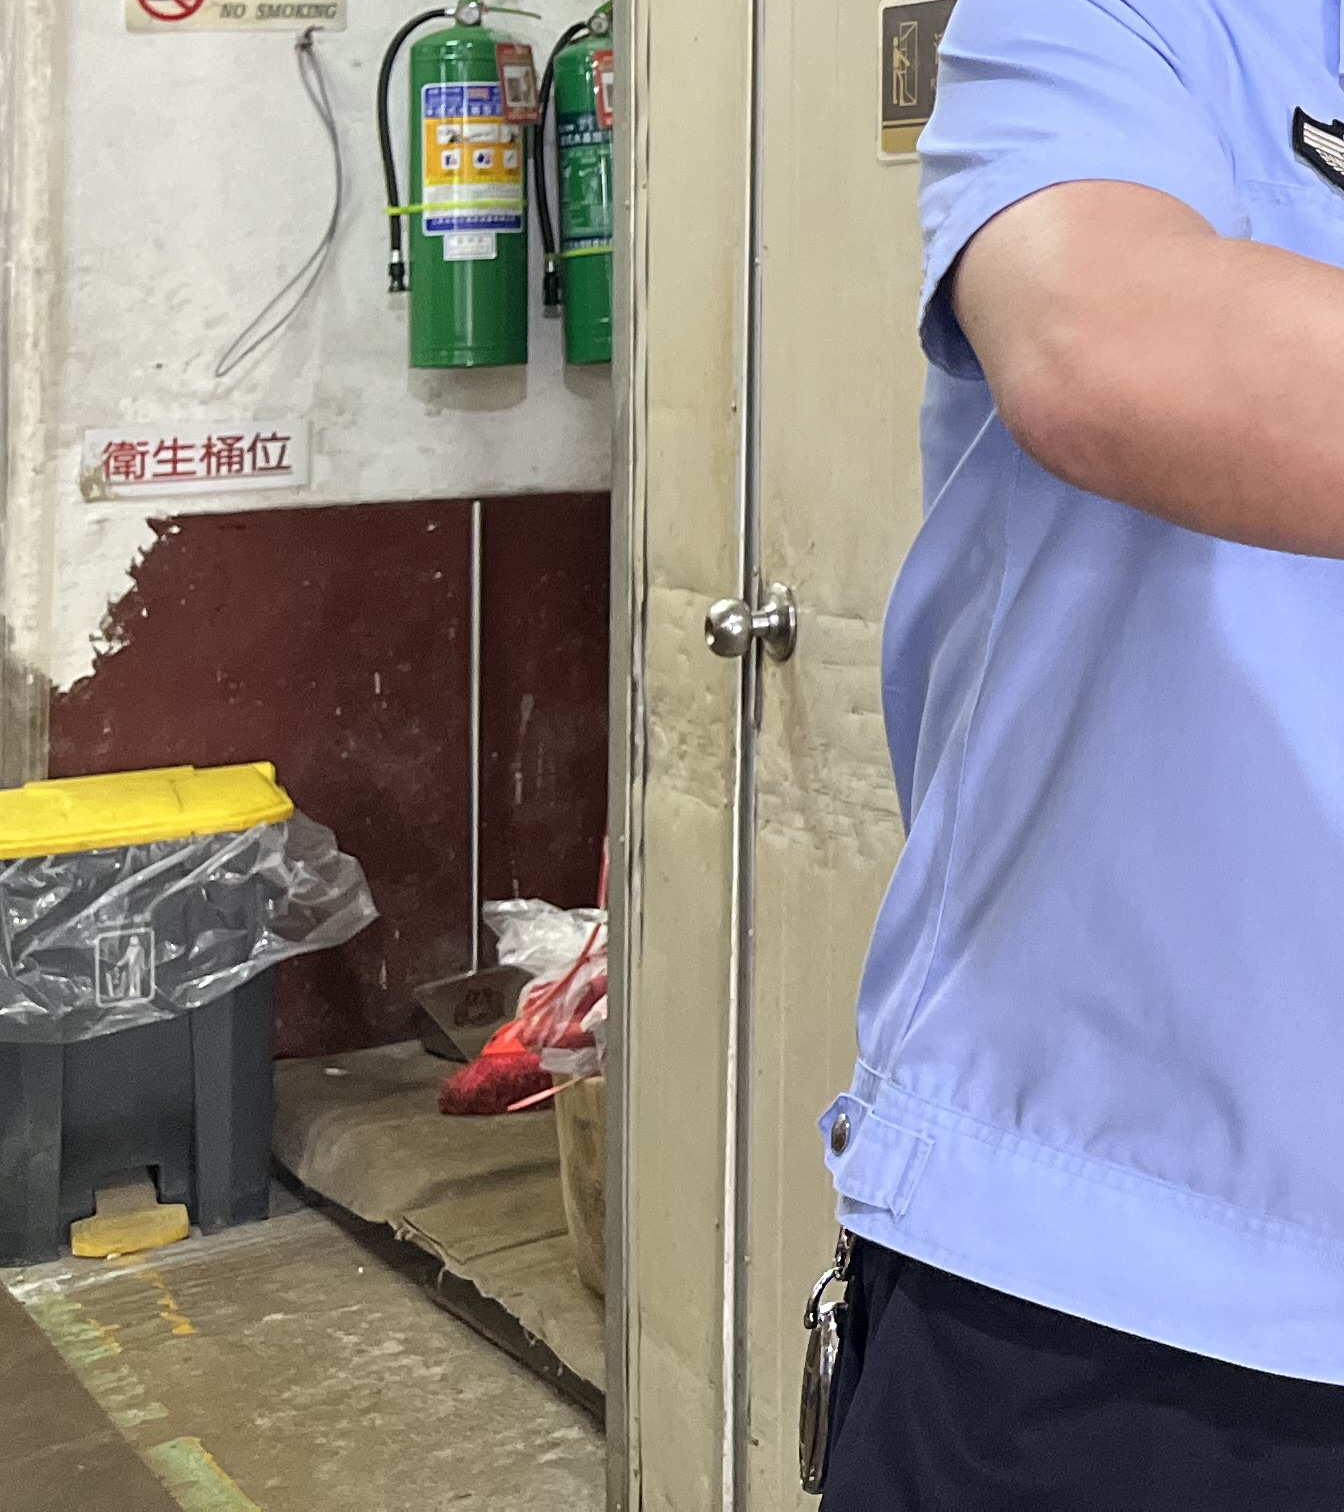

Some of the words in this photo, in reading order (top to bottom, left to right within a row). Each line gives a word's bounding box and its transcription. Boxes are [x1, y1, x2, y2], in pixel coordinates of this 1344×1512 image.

[219, 3, 246, 19] NO
[255, 2, 338, 20] SMOKING
[102, 431, 292, 481] 衛生桶位
